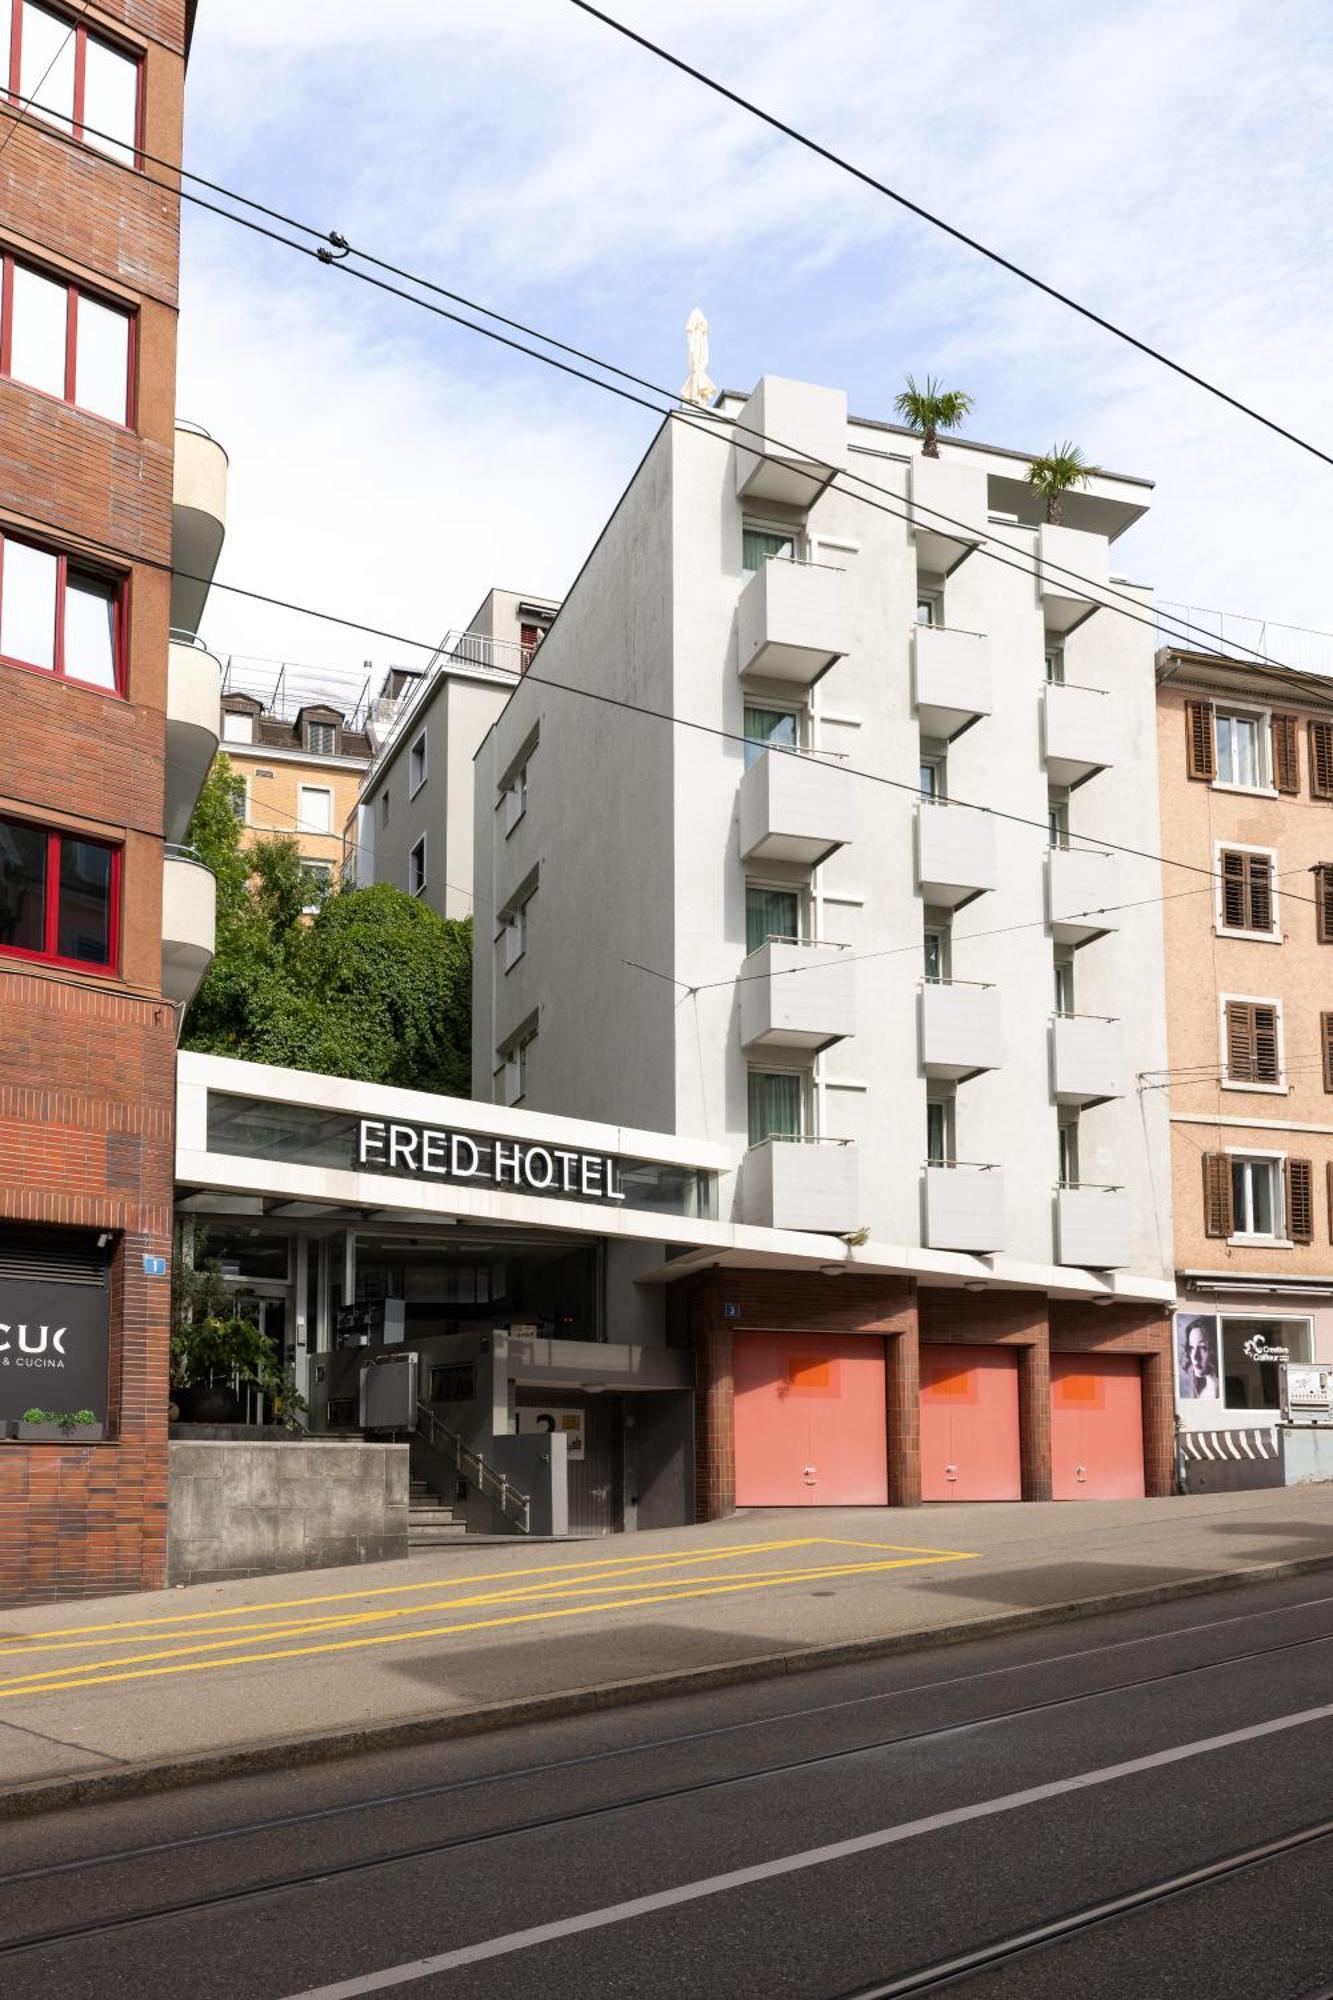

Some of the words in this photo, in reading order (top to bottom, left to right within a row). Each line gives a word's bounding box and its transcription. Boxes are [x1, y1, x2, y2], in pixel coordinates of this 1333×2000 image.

[359, 1119, 479, 1177] FRED
[495, 1141, 626, 1199] HOTEL
[2, 1357, 10, 1366] &
[15, 1358, 65, 1368] CUCINA
